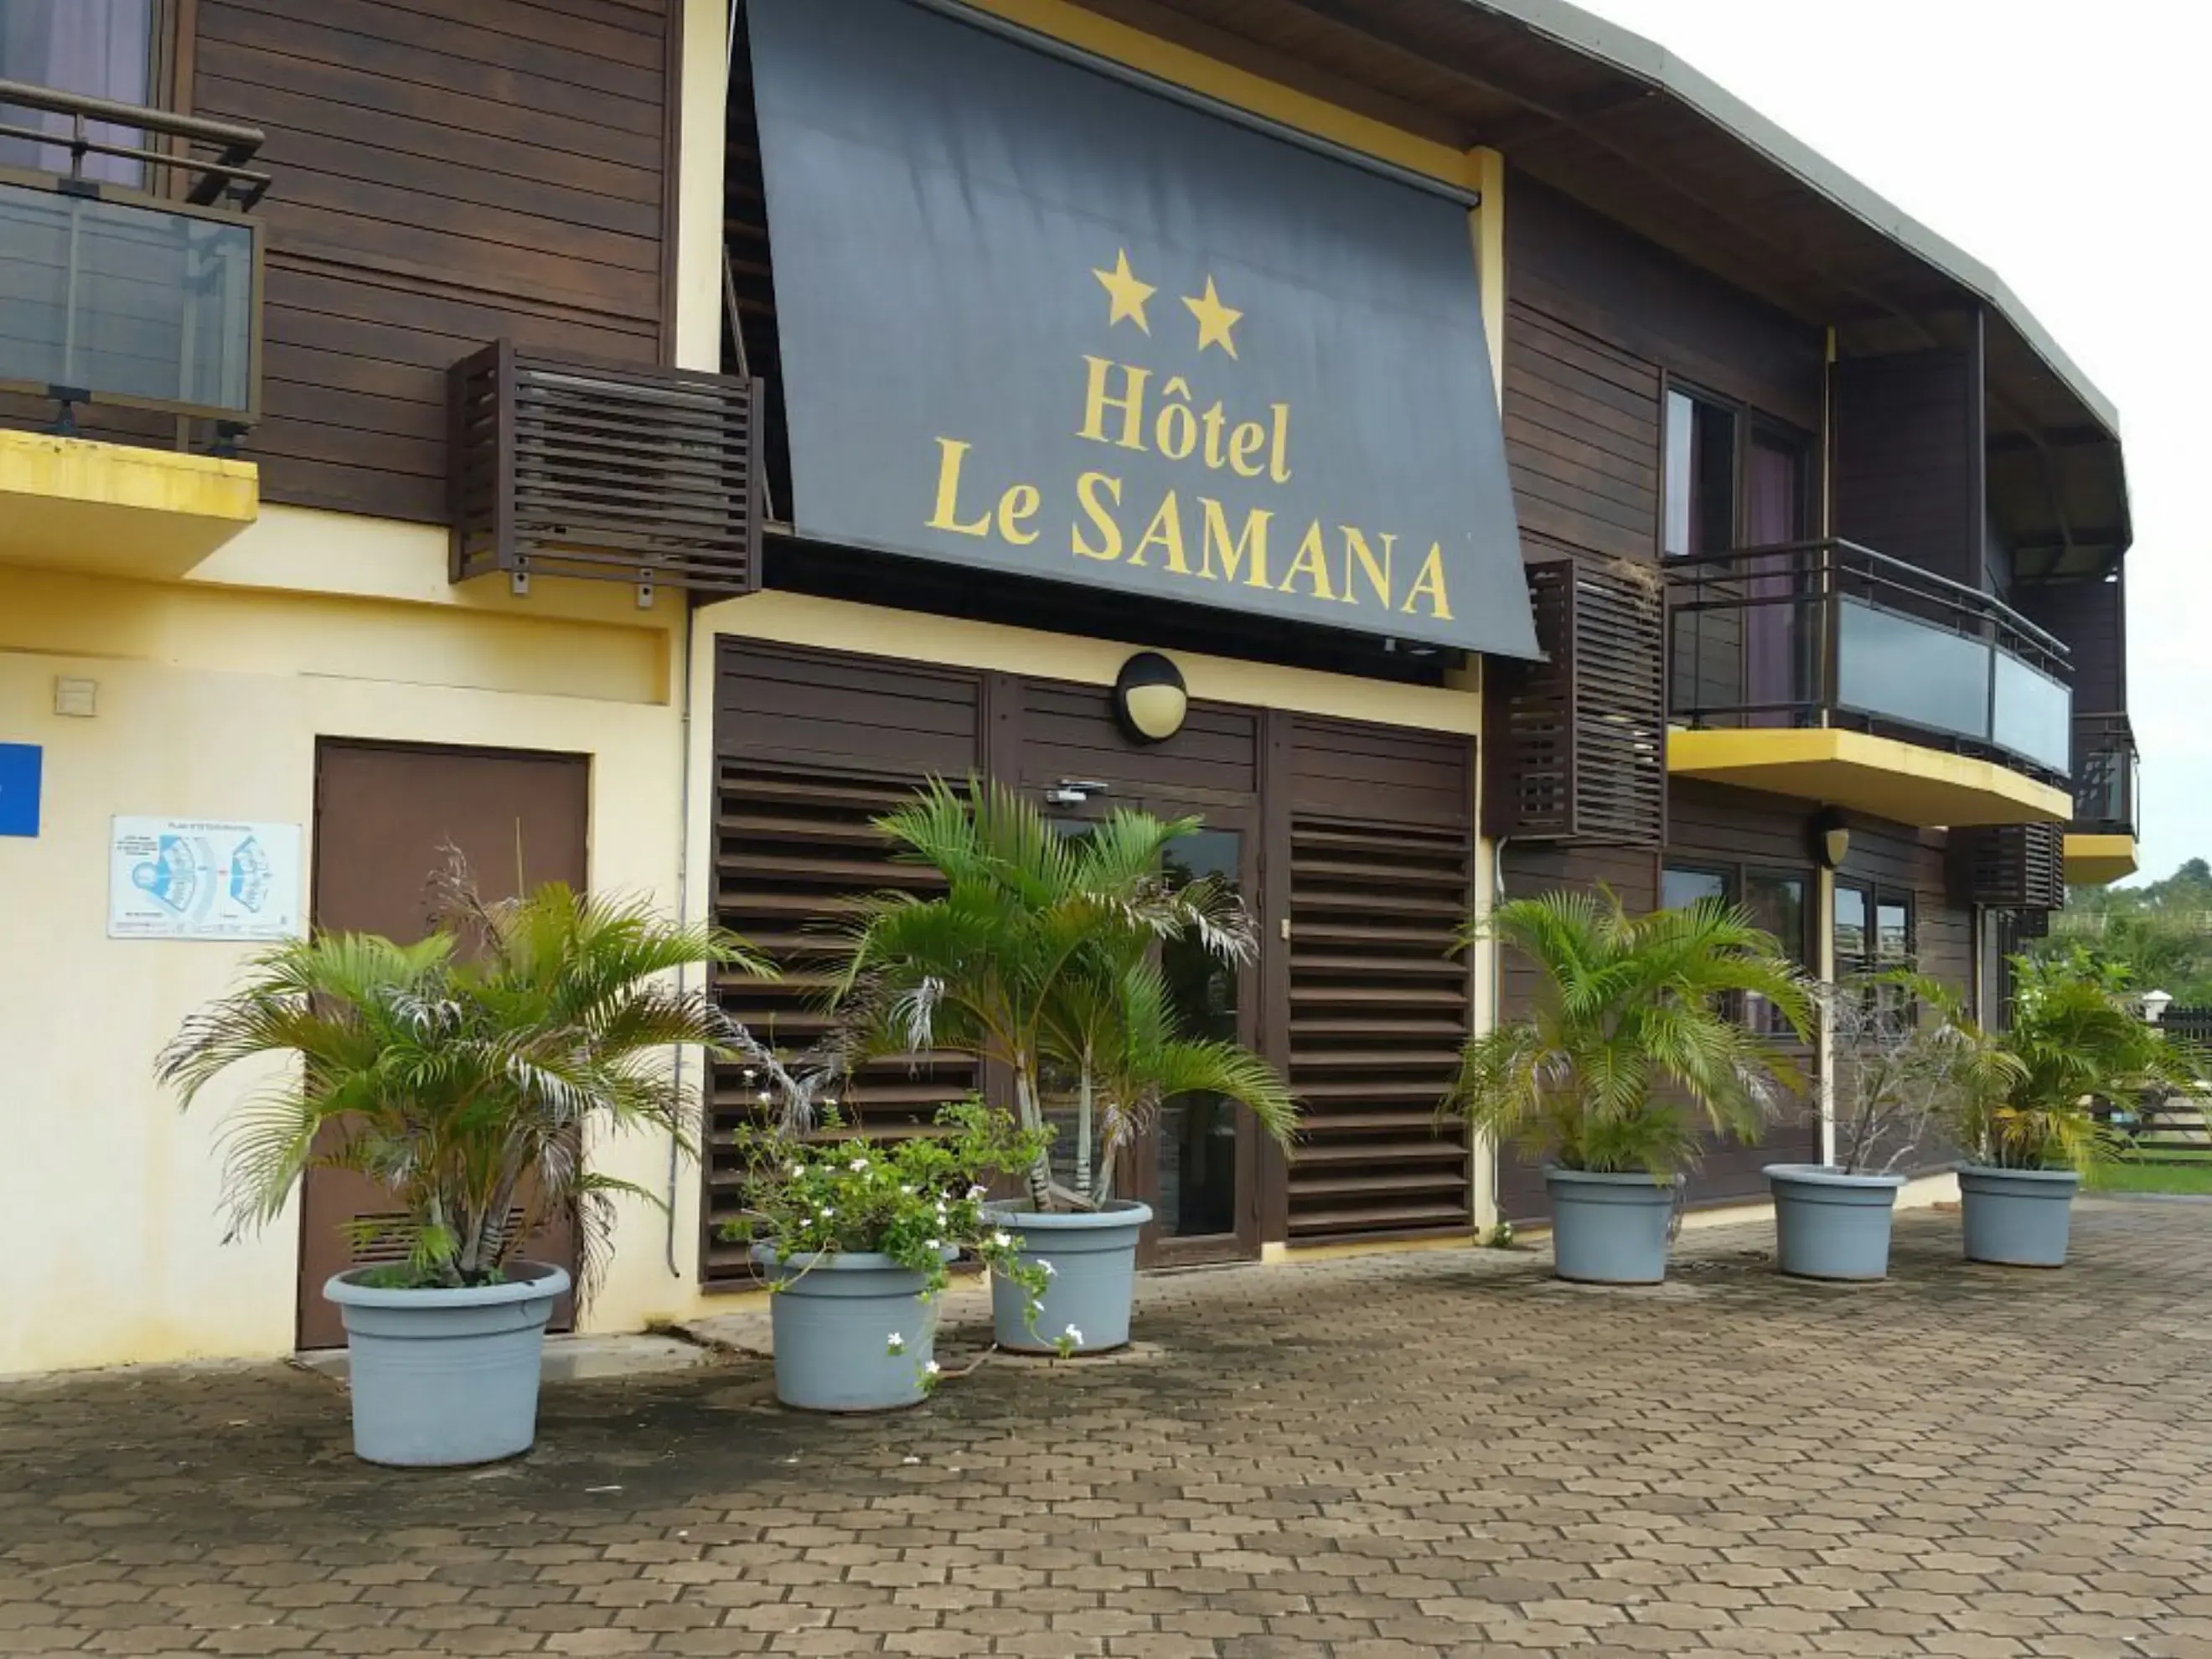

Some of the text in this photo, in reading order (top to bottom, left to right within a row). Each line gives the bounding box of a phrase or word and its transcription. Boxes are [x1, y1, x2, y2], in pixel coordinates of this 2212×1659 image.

[1076, 354, 1291, 483] Hôtel
[924, 436, 1454, 622] Le SAMANA
